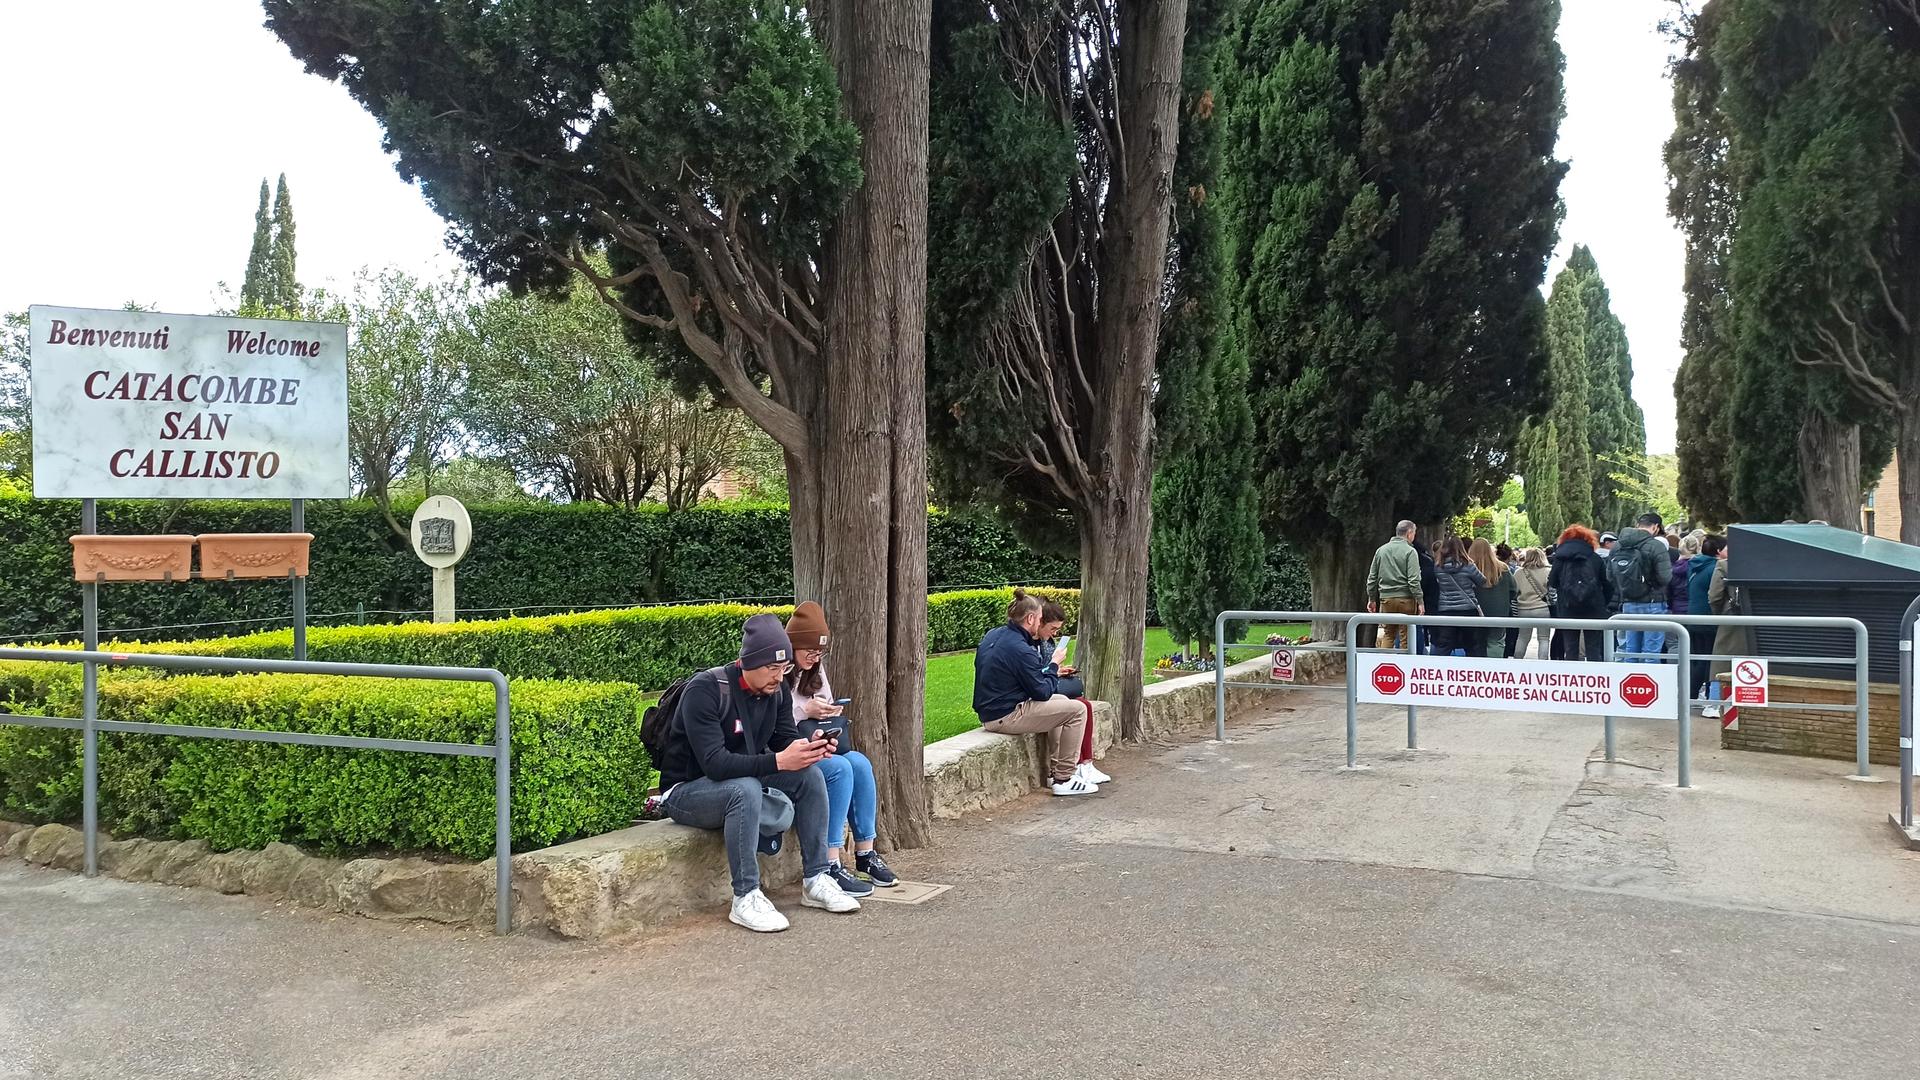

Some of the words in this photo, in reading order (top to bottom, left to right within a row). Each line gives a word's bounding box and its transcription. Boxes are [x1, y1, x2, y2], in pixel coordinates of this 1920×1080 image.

[47, 319, 169, 350] Benvenuti
[227, 329, 321, 358] Welcome
[84, 370, 300, 406] CATACOMBE
[159, 411, 233, 441] SAN
[109, 448, 280, 479] CALLISTO
[1376, 675, 1400, 683] STOP
[1410, 667, 1444, 681] AREA
[1446, 669, 1515, 685] RISERVATA
[1518, 672, 1532, 685] AI
[1535, 673, 1611, 689] VISITATORI
[1625, 686, 1652, 695] STOP
[1410, 683, 1445, 696] DELLE
[1447, 684, 1520, 700] CATACOMBE
[1523, 688, 1548, 702] SAN
[1551, 689, 1611, 705] CALLISTO
